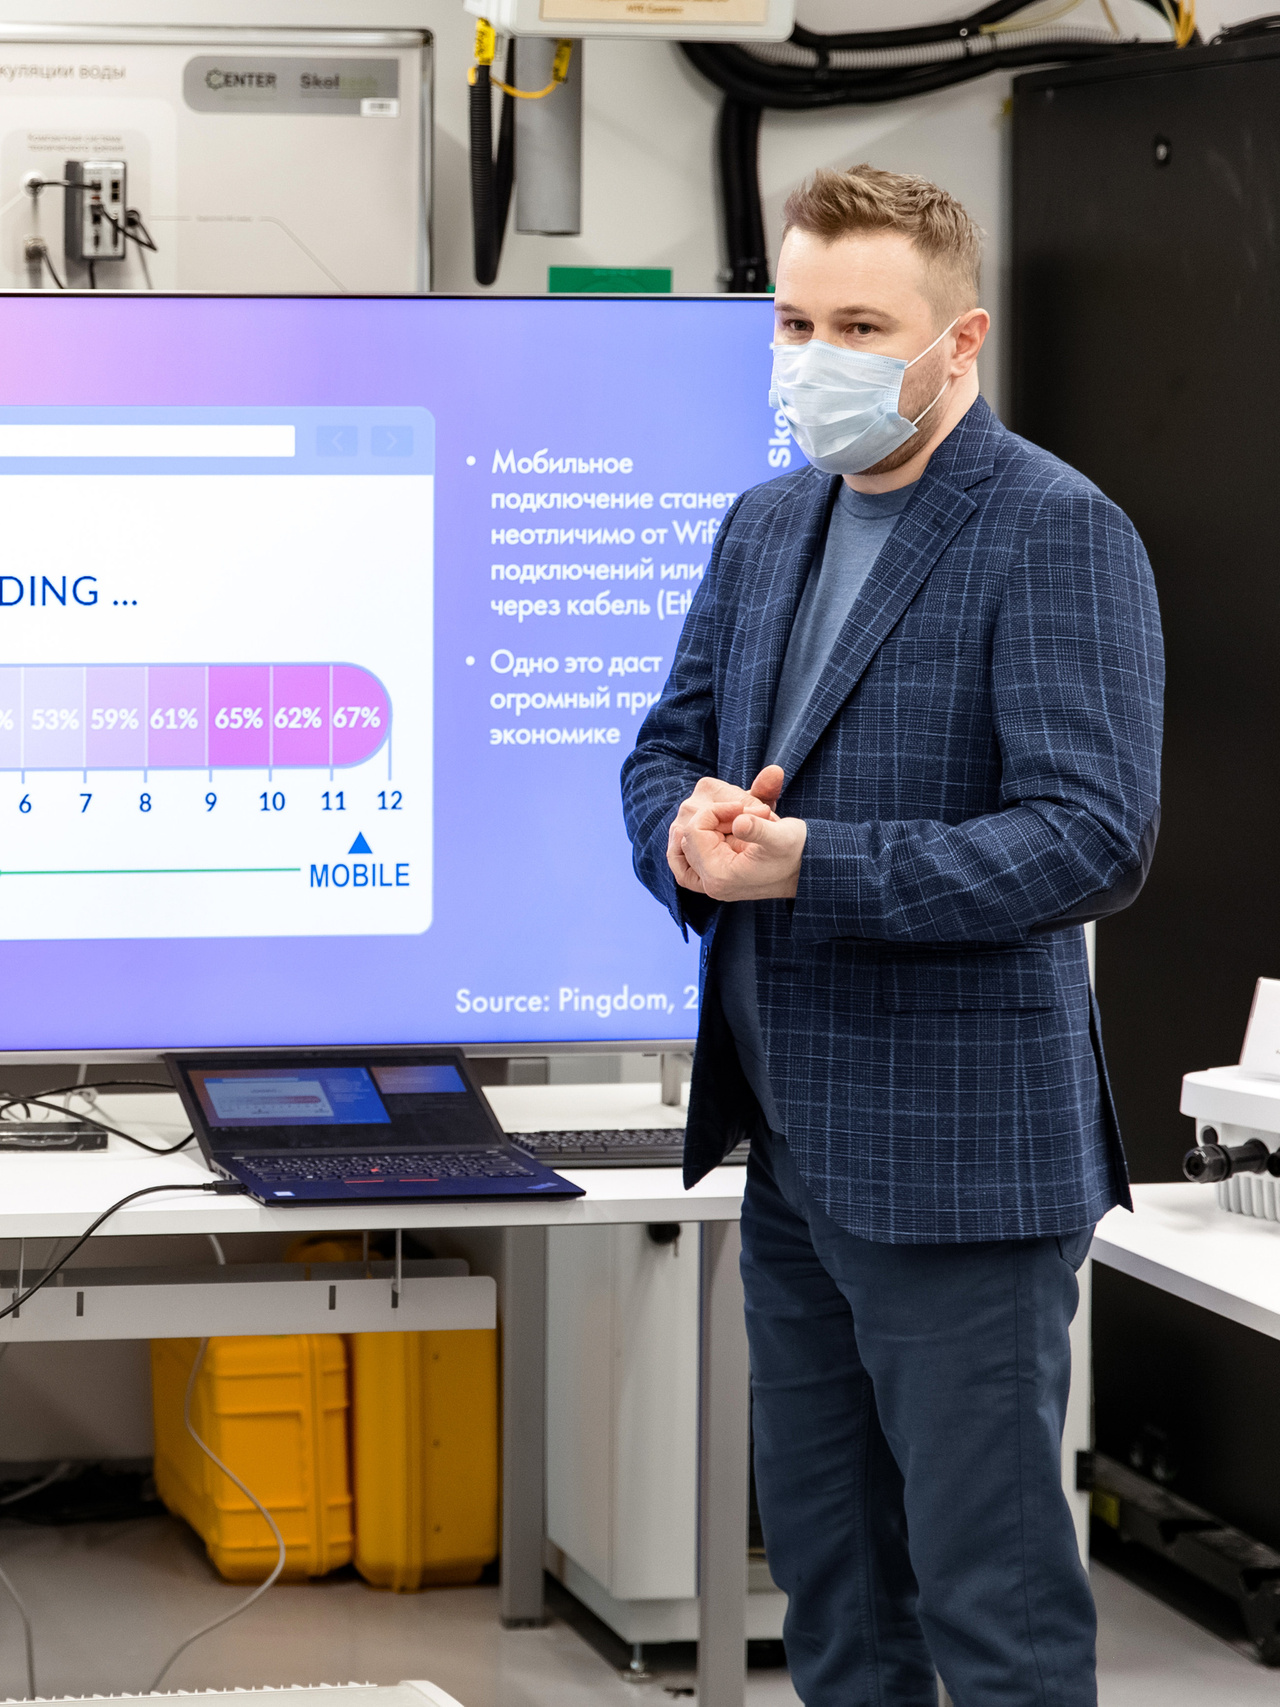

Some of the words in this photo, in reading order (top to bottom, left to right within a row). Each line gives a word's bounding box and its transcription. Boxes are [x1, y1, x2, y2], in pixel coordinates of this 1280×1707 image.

[78, 64, 127, 81] воды
[491, 447, 634, 474] Мобильное
[491, 492, 654, 513] подключение
[659, 492, 738, 509] станет
[491, 528, 636, 545] неотличимо
[640, 527, 669, 545] от
[671, 517, 721, 545] Wif
[490, 557, 654, 585] подключений
[660, 563, 704, 580] или
[490, 599, 561, 624] через
[567, 589, 651, 616] кабель
[490, 648, 560, 678] Одно
[564, 656, 604, 674] это
[607, 656, 664, 677] даст
[489, 685, 611, 717] огромный
[31, 708, 80, 731] 53%
[90, 708, 140, 730] 59%
[149, 708, 199, 730] 61%
[214, 707, 264, 729] 65%
[274, 707, 323, 730] 62%
[331, 706, 382, 729] 67%
[489, 727, 621, 745] экономике
[18, 793, 32, 814] 6
[79, 793, 93, 813] 7
[139, 792, 152, 813] 8
[204, 792, 218, 812] 9
[259, 791, 286, 812] 10
[321, 790, 346, 811] 11
[377, 790, 403, 810] 12
[310, 862, 410, 888] MOBILE
[455, 988, 550, 1013] Source:
[559, 984, 675, 1018] Pingdom,
